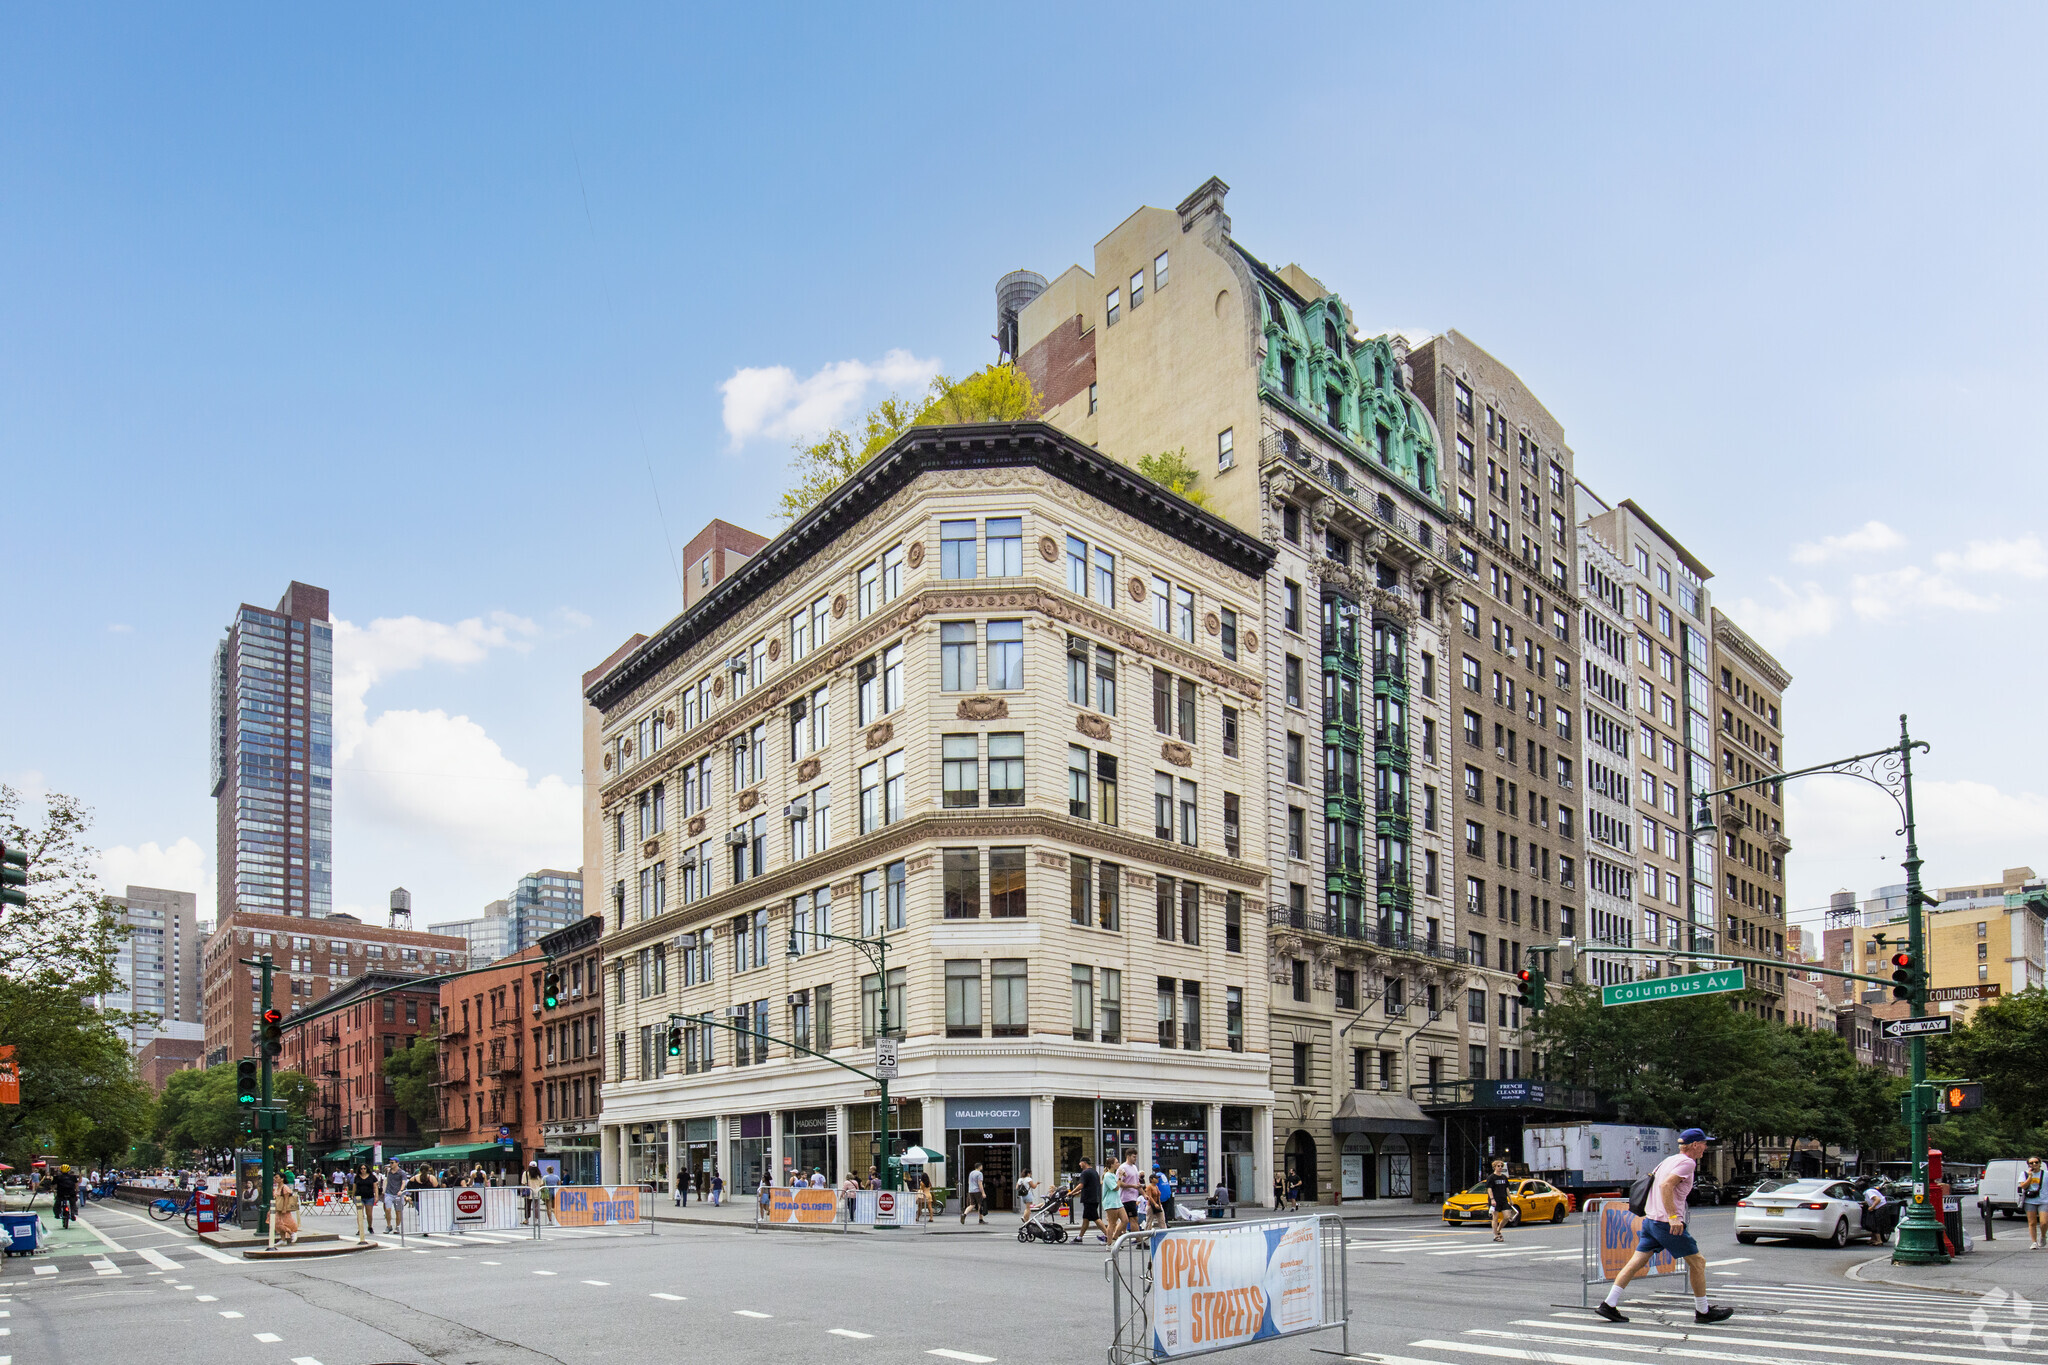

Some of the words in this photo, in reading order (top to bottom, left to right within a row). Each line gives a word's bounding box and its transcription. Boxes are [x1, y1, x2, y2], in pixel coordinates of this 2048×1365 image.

[1615, 980, 1700, 1000] Columbus
[1706, 976, 1729, 988] Av
[1929, 987, 1980, 1002] COLUMBUS
[1986, 985, 1997, 993] AV
[1892, 1023, 1911, 1033] ONE
[1920, 1021, 1942, 1030] WAY
[879, 1054, 896, 1066] 25
[955, 1110, 1021, 1118] (MALIN+GOETZ)
[560, 1191, 588, 1212] OPEN
[593, 1200, 635, 1221] STREETS
[774, 1201, 799, 1210] ROAD
[801, 1202, 833, 1211] CLOSED
[1605, 1208, 1636, 1250] OPEN
[1161, 1238, 1216, 1291] OPEN
[1191, 1285, 1264, 1344] STREETS
